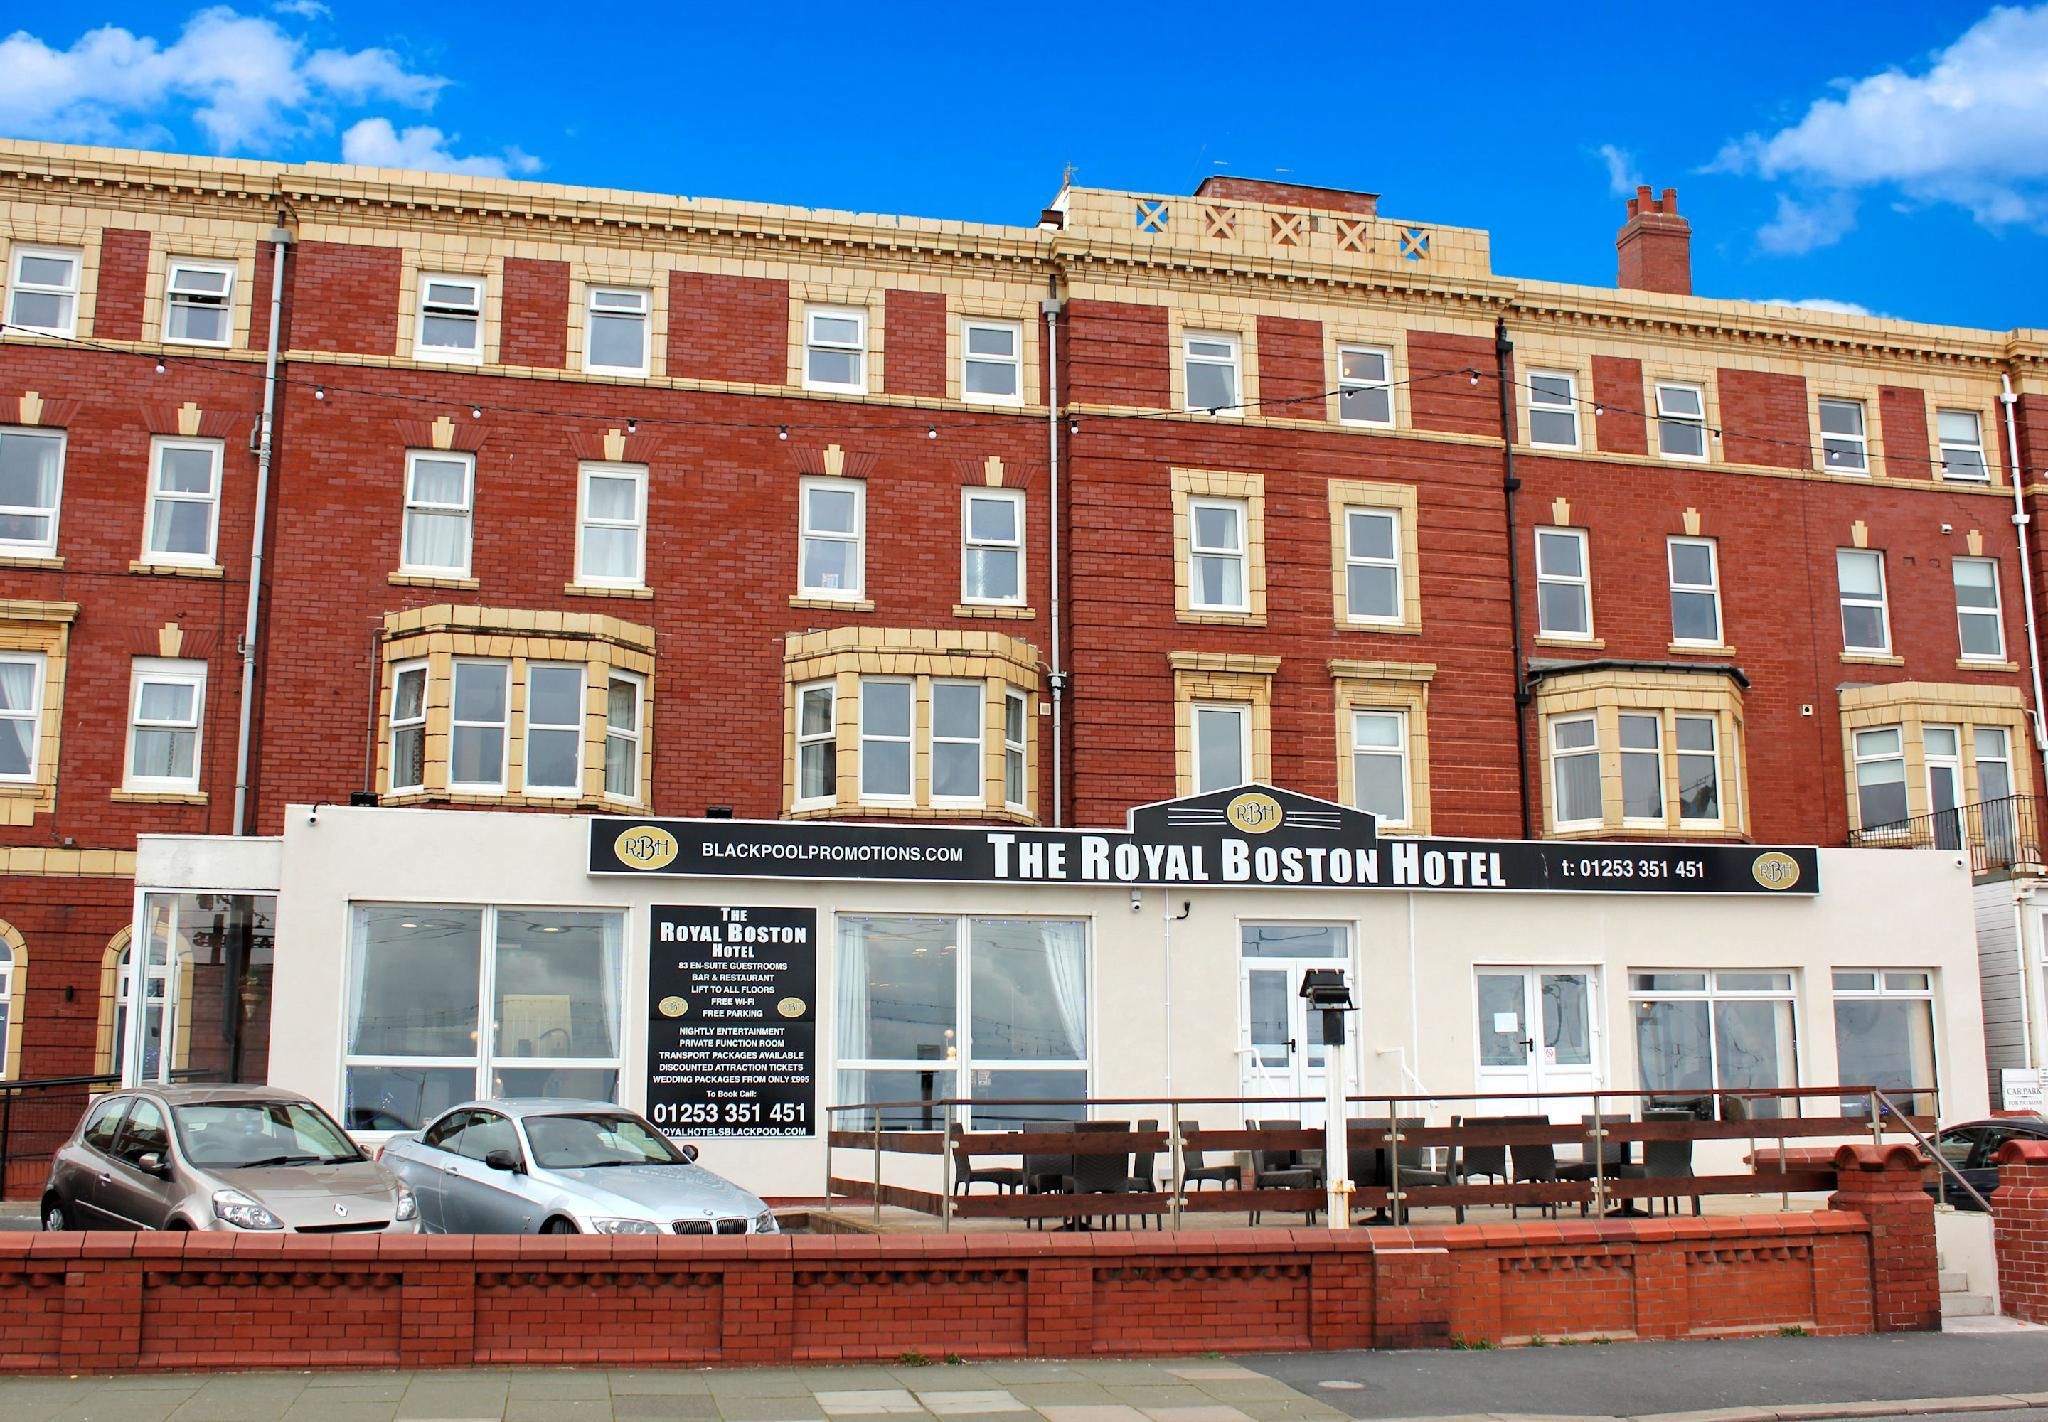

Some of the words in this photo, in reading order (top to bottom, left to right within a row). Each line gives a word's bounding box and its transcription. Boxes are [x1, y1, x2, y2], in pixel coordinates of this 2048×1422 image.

[1236, 802, 1275, 826] RBH
[624, 836, 669, 860] RBH
[702, 842, 963, 862] BLACKPOOLPROMOTIONS.COM
[987, 833, 1067, 878] THE
[1081, 835, 1209, 881] ROYAL
[1221, 838, 1378, 884] BOSTON
[1391, 843, 1506, 887] HOTEL
[1562, 859, 1575, 877] t:
[1580, 859, 1633, 878] 01253
[1638, 860, 1668, 878] 351
[1675, 860, 1704, 879] 451
[1758, 861, 1793, 883] RBH
[720, 907, 748, 921] THE
[660, 922, 722, 942] ROYAL
[727, 923, 807, 944] BOSTON
[712, 943, 755, 958] HOTEL
[678, 962, 689, 970] 83
[690, 962, 728, 970] EN-SUITE
[730, 962, 788, 970] GUESTROOMS
[692, 974, 710, 982] BAR
[712, 974, 718, 982] &
[720, 974, 775, 982] RESTAURANT
[691, 986, 709, 994] LIFT
[710, 986, 722, 994] TO
[723, 986, 740, 994] ALL
[741, 986, 775, 994] FLOORS
[711, 998, 733, 1006] FREE
[734, 998, 755, 1006] WI-FI
[703, 1009, 725, 1018] FREE
[726, 1009, 763, 1018] PARKING
[679, 1027, 715, 1036] NIGHTLY
[716, 1027, 785, 1036] ENTERTAINMENT
[679, 1039, 714, 1048] PRIVATE
[715, 1039, 757, 1048] FUNCTION
[759, 1039, 785, 1048] ROOM
[659, 1051, 711, 1060] TRANSPORT
[712, 1051, 758, 1060] PACKAGES
[759, 1051, 805, 1060] AVAILABLE
[659, 1063, 714, 1072] DISCOUNTED
[715, 1063, 768, 1072] ATTRACTION
[769, 1063, 804, 1072] TICKETS
[653, 1075, 693, 1084] WEDDING
[694, 1075, 740, 1084] PACKAGES
[742, 1075, 766, 1084] FROM
[767, 1075, 790, 1084] ONLY
[706, 1090, 716, 1098] To
[717, 1090, 738, 1098] Book
[739, 1090, 758, 1098] Call:
[2006, 1087, 2021, 1095] CAR
[2022, 1087, 2042, 1095] PARK
[653, 1102, 719, 1123] 01253
[724, 1102, 760, 1123] 351
[769, 1102, 805, 1123] 451
